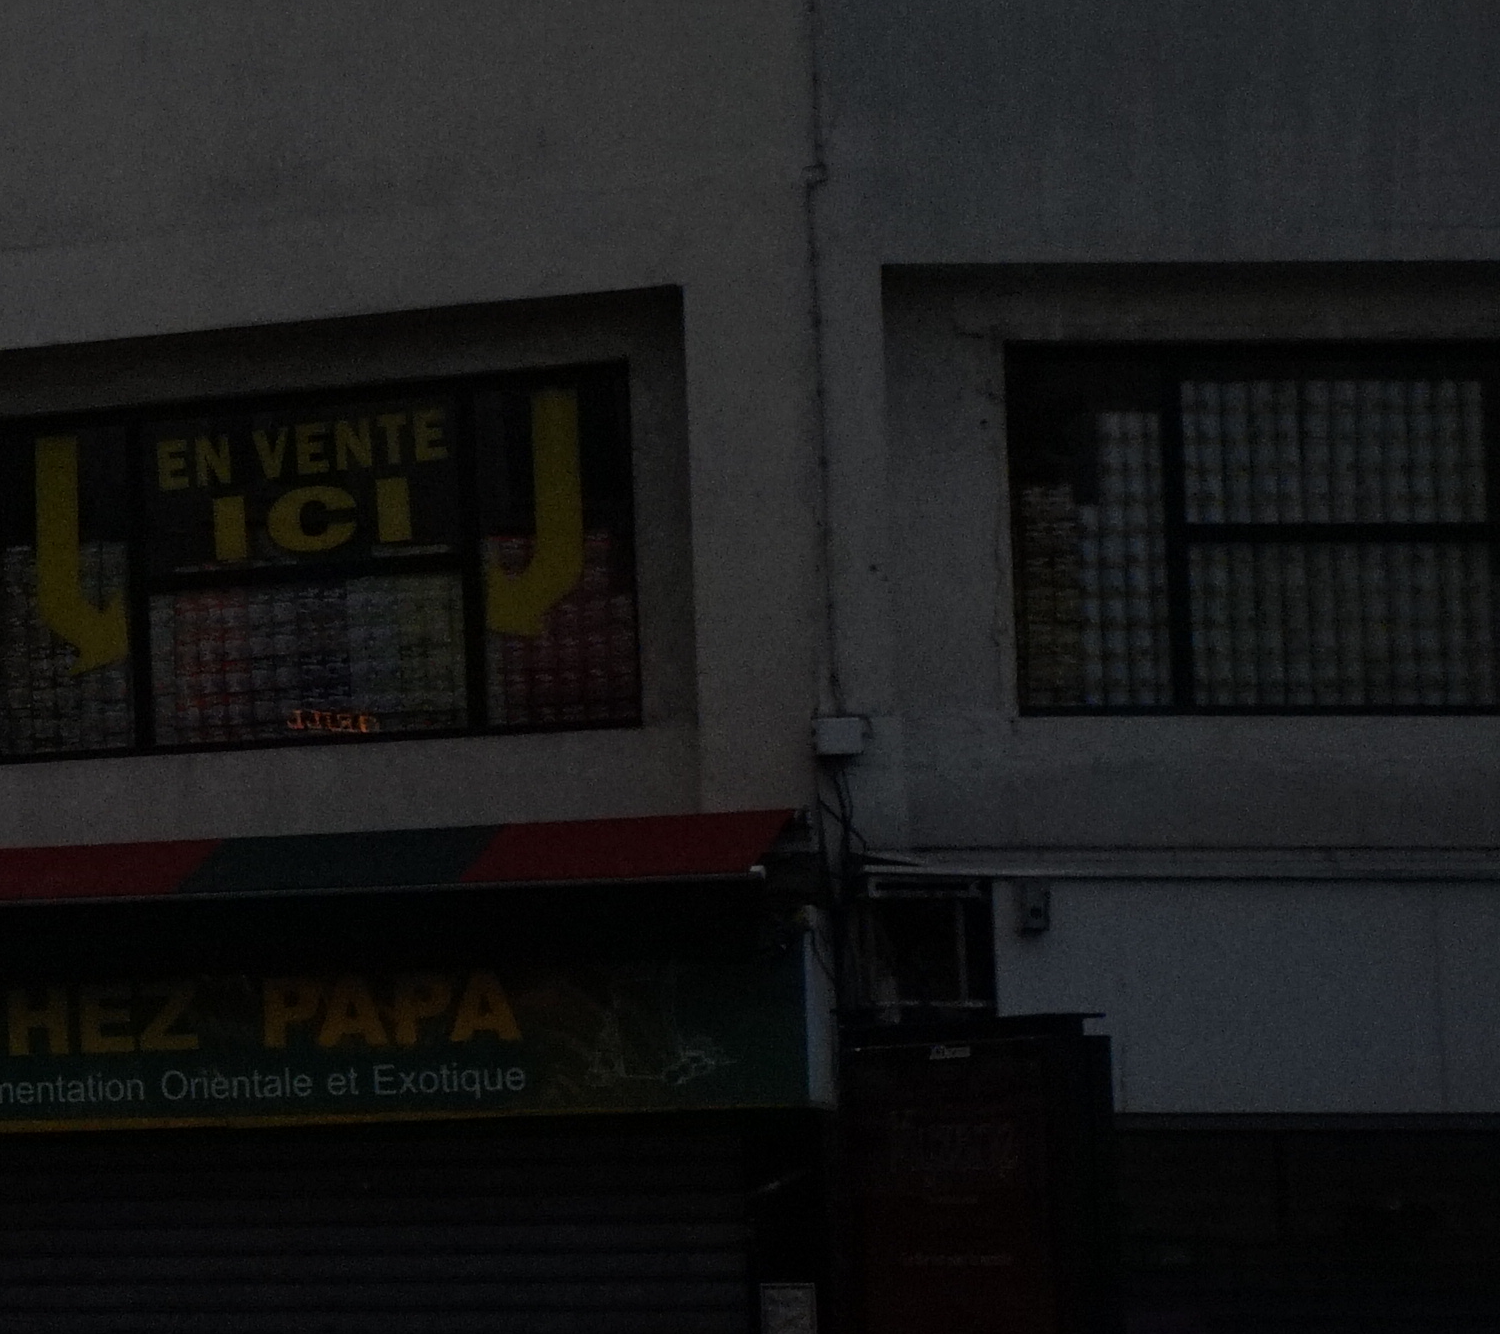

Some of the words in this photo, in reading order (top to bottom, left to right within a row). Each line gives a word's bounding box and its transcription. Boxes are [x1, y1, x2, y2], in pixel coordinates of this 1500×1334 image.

[156, 435, 233, 491] EN
[251, 407, 449, 481] VENTE
[212, 476, 413, 560] ICI
[262, 969, 522, 1050] PAPA
[326, 1068, 358, 1096] et
[373, 1060, 527, 1095] Exotique
